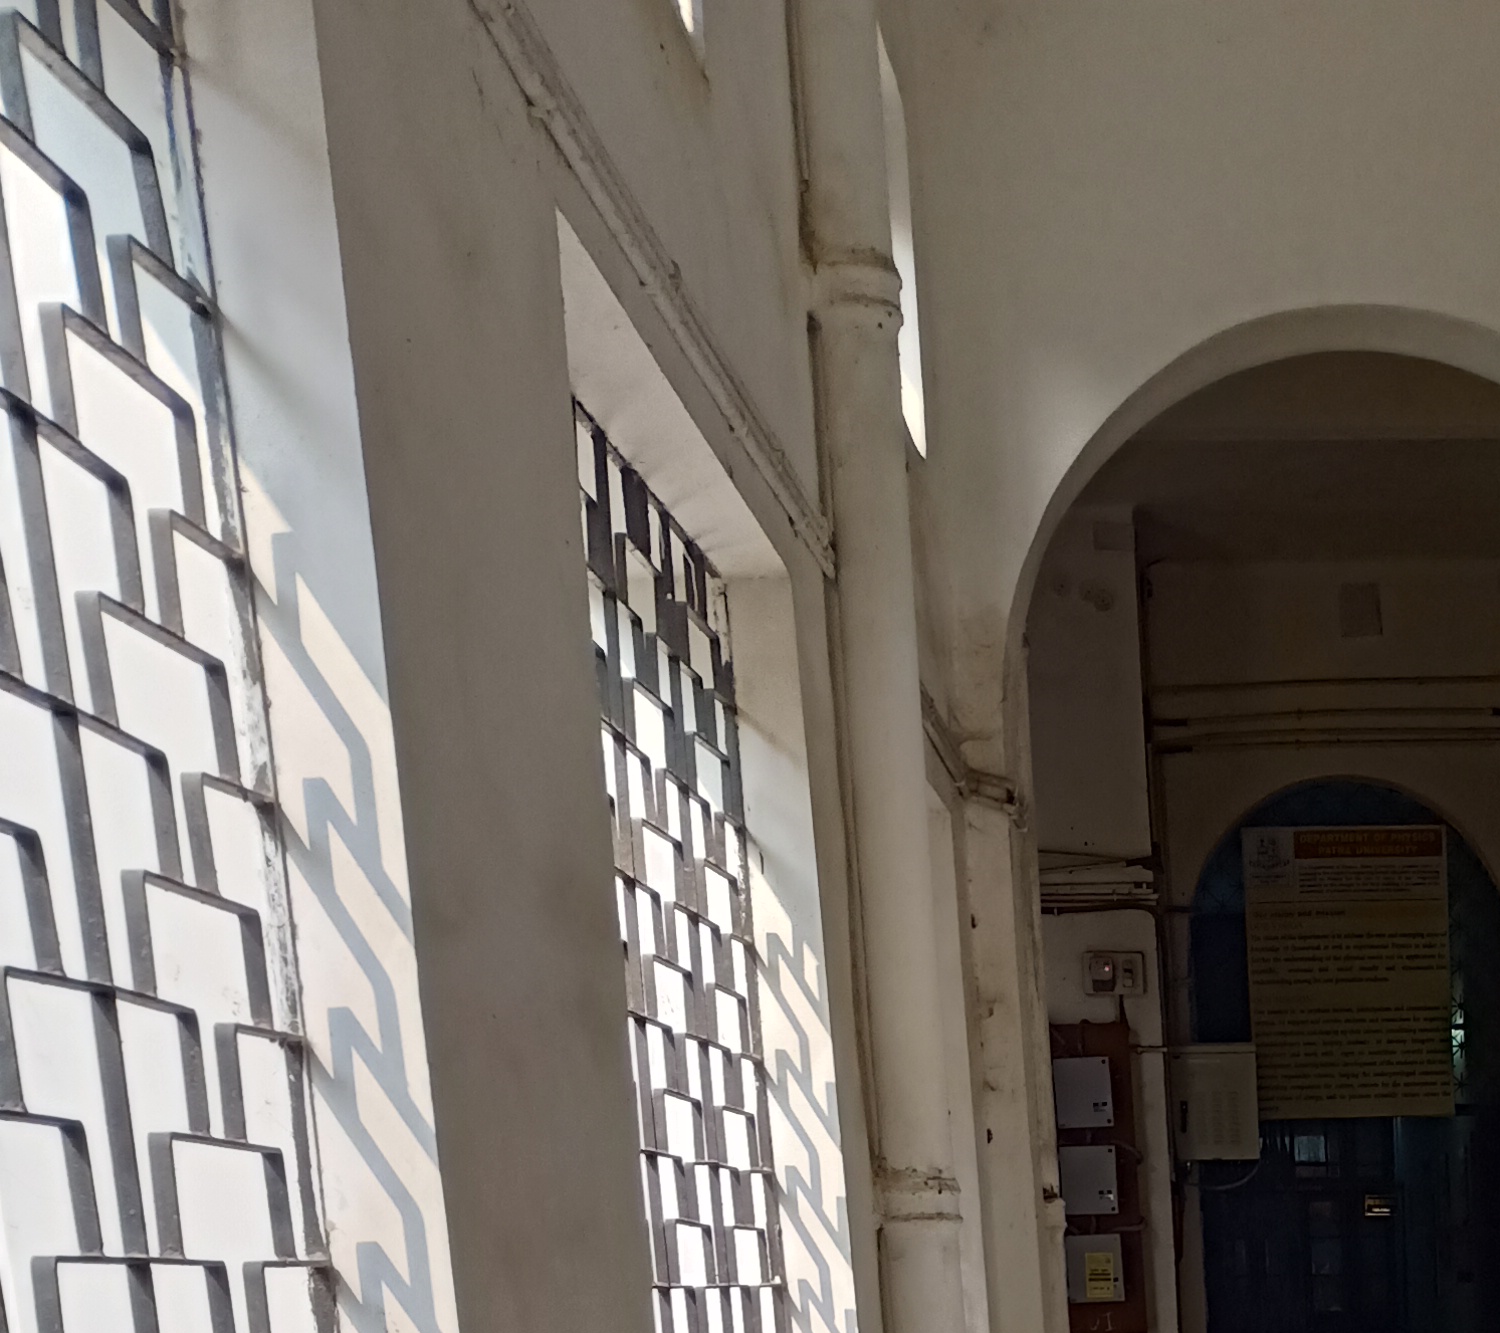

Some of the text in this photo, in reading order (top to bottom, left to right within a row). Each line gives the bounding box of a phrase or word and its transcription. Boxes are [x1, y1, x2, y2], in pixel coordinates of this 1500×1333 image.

[1299, 832, 1436, 844] DEPARTMENT OF PHYSICS
[1318, 845, 1418, 855] PATNA UNIVERSITY
